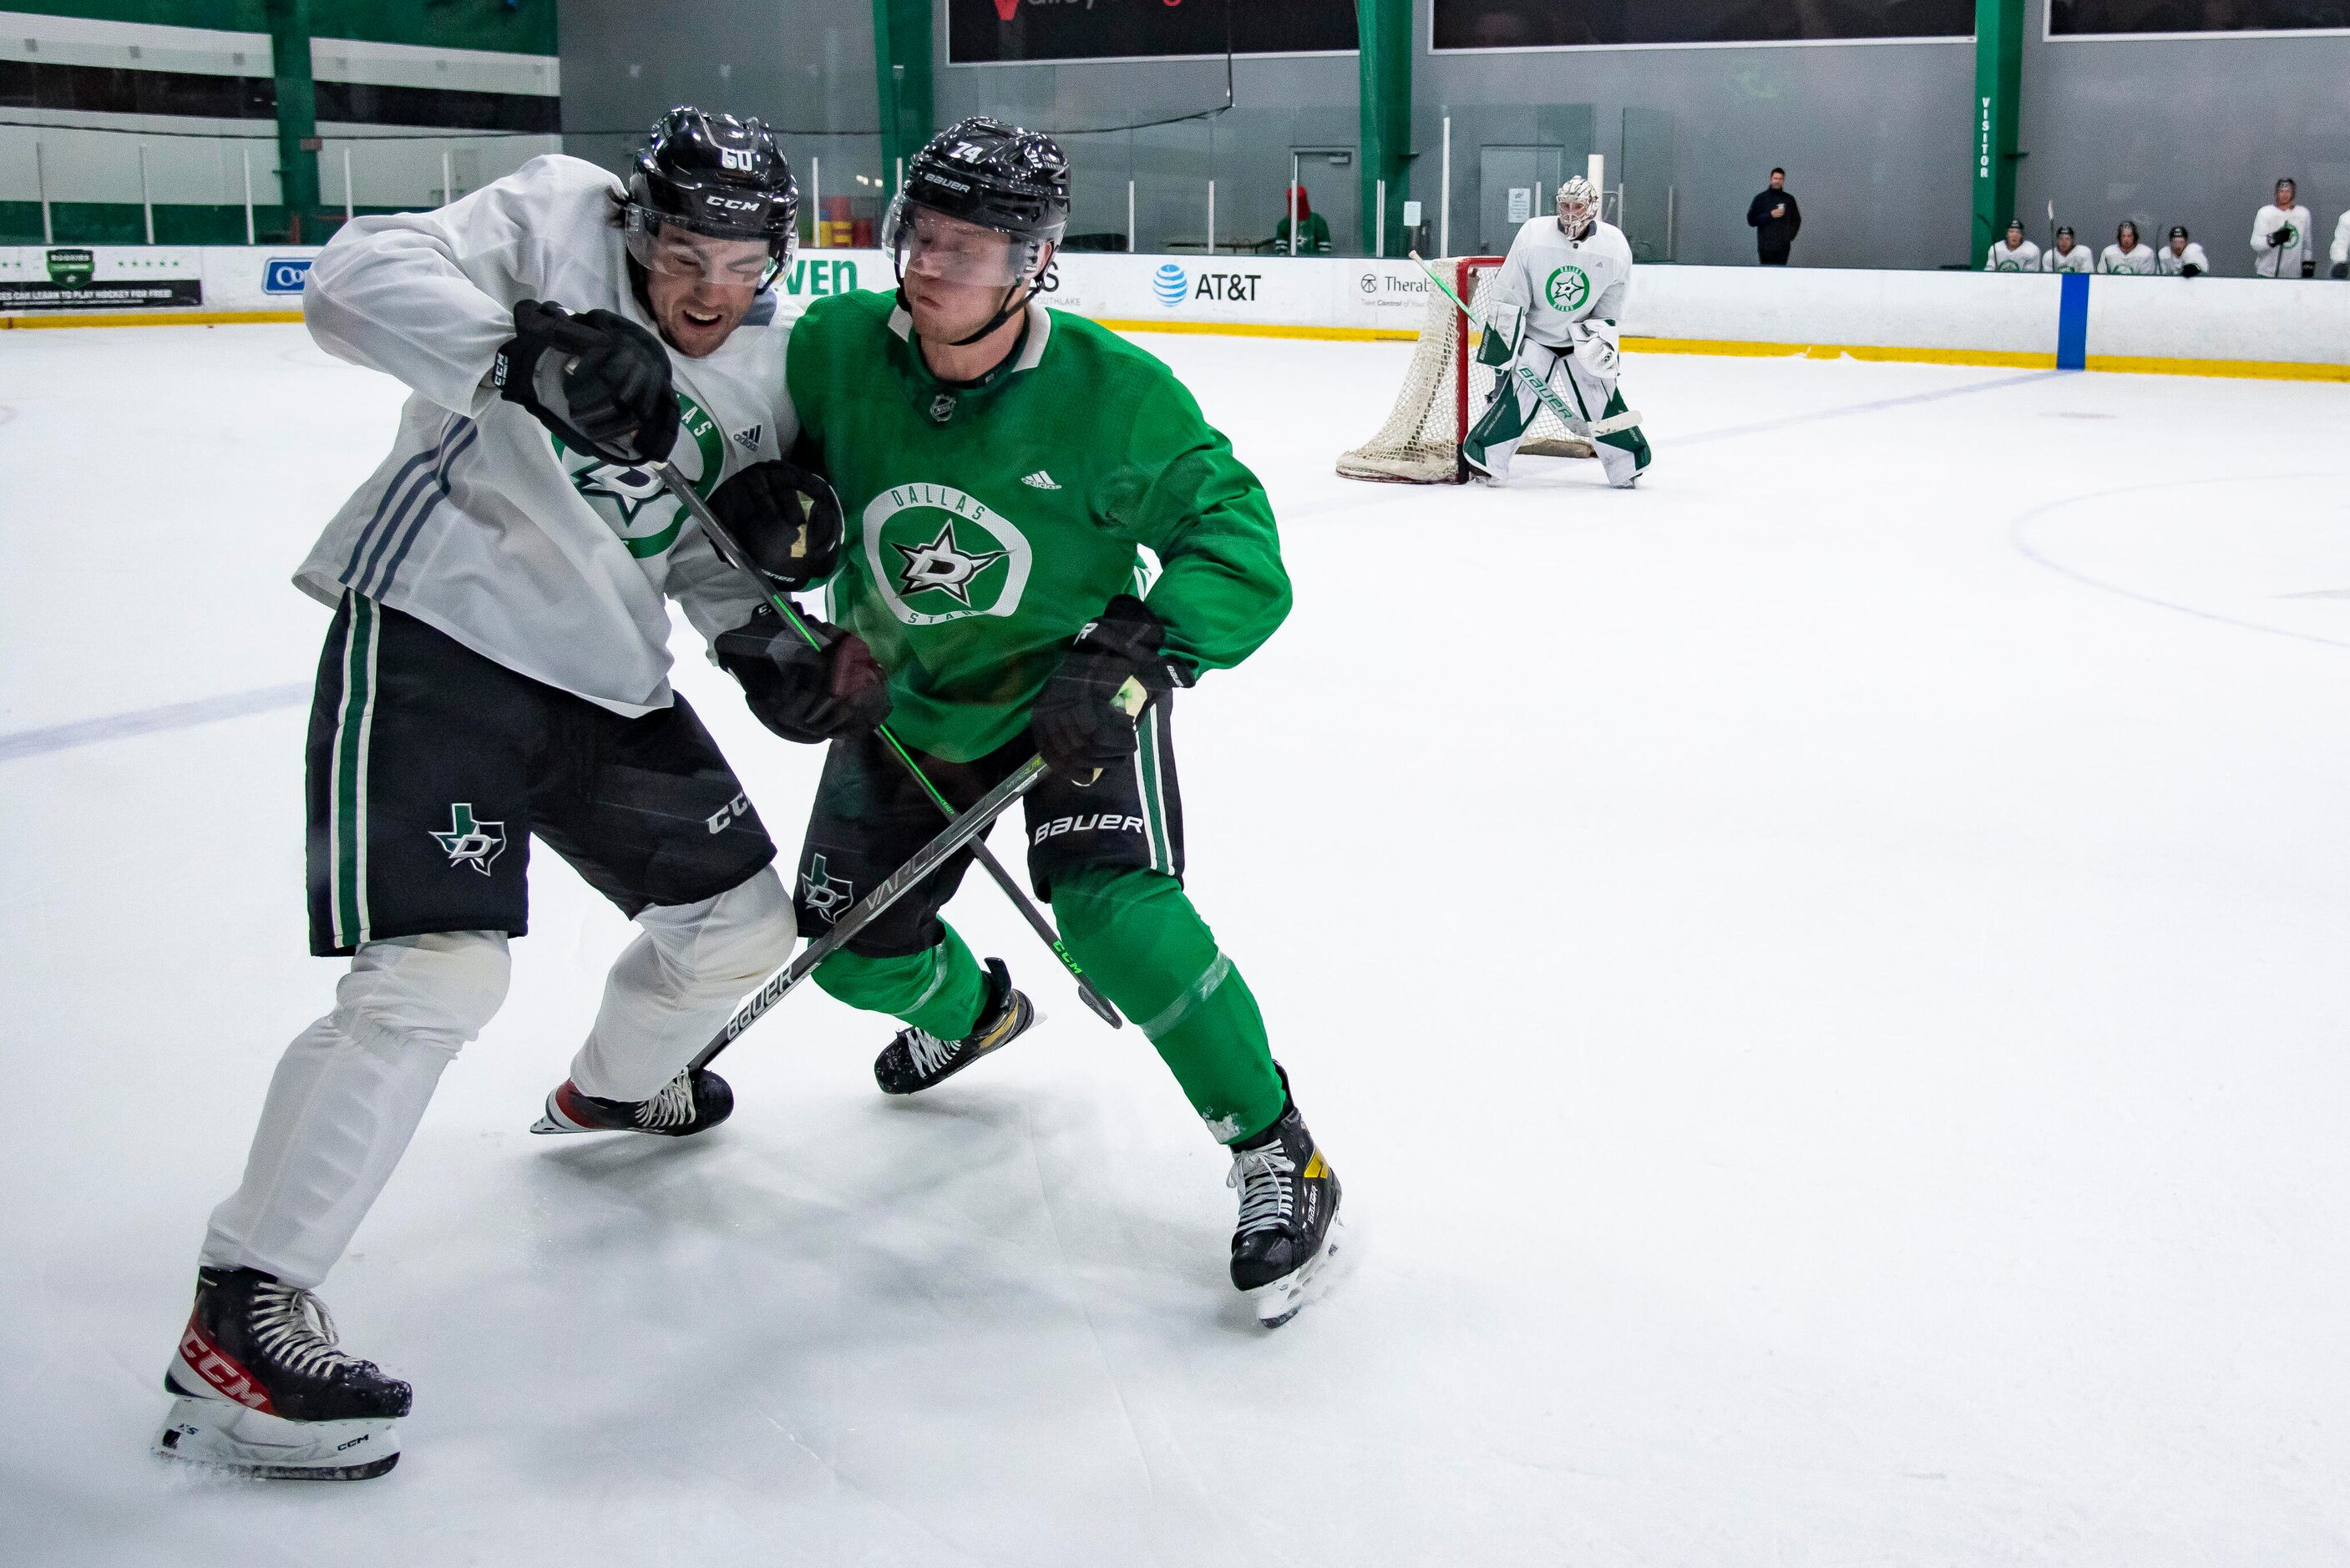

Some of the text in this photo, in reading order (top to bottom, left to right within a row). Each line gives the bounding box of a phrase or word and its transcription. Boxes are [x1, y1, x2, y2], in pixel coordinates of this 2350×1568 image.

[1980, 97, 1991, 178] VISITOR
[950, 142, 983, 164] 74
[924, 173, 970, 193] BAUER
[707, 195, 760, 211] CCM
[276, 266, 306, 286] Co
[1195, 274, 1261, 301] AT&T
[1038, 296, 1081, 306] OUTHLAKE
[494, 352, 504, 386] CCM
[1519, 367, 1573, 419] BAUER
[1021, 478, 1061, 490] adidas
[891, 485, 985, 520] DALLAS
[1035, 814, 1143, 846] BAUER
[1053, 940, 1082, 974] CCM
[727, 964, 793, 1041] BAUER
[179, 1328, 267, 1408] CCM
[337, 1434, 369, 1450] CCM
